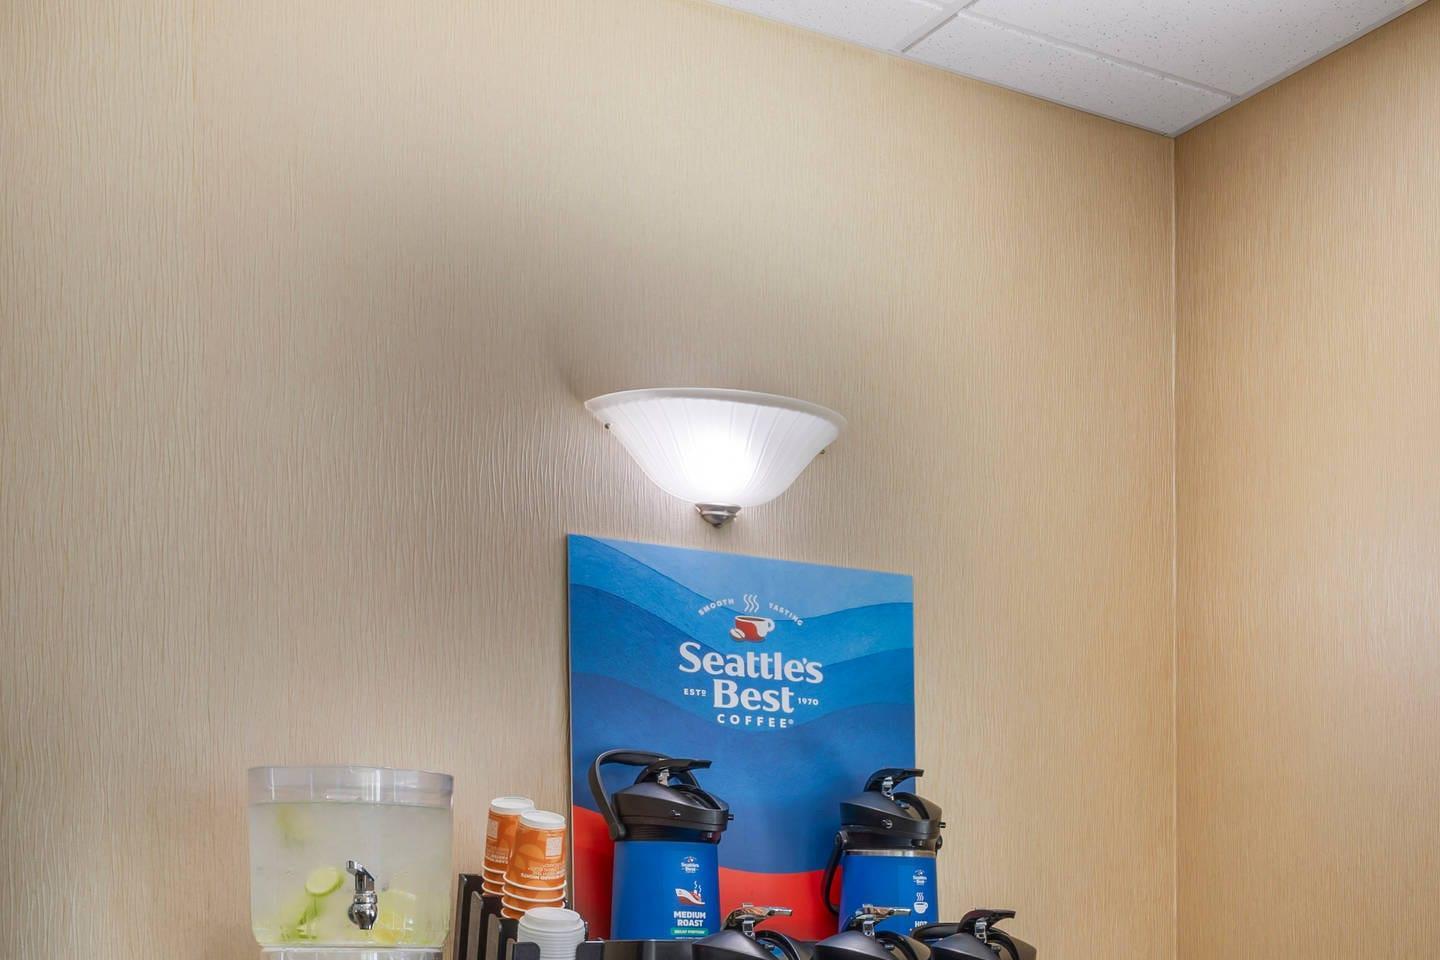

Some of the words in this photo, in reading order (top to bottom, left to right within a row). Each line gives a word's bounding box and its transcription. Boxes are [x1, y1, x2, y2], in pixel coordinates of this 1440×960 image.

[698, 598, 735, 616] SMOOTH
[768, 602, 804, 626] TASTING
[678, 641, 824, 684] Seattle's
[712, 678, 795, 713] Best
[798, 697, 819, 706] 1970
[673, 910, 706, 920] MEDIUM
[677, 919, 704, 927] ROAST
